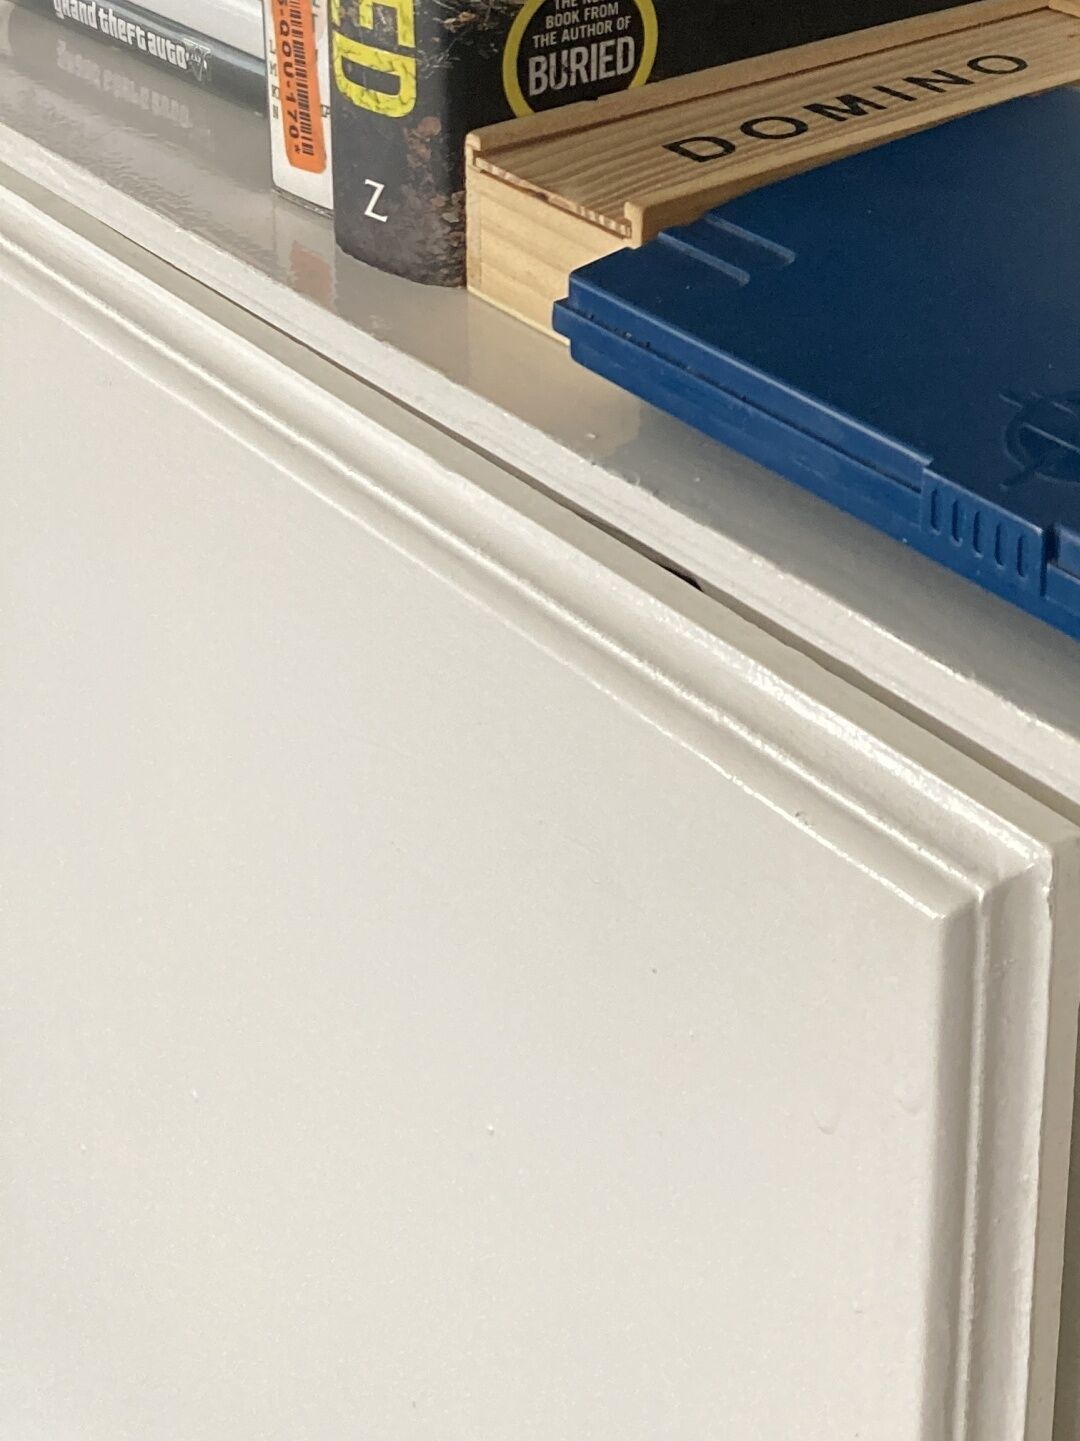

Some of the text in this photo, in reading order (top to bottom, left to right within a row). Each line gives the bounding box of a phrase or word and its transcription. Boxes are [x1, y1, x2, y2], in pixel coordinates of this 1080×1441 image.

[98, 7, 147, 51] theft
[147, 31, 188, 70] auto
[533, 16, 632, 49] THE AUTHOR OF
[545, 2, 619, 29] BOOK FROM
[528, 36, 636, 97] BURIED
[662, 54, 1028, 162] DOMINO
[363, 178, 390, 222] Z
